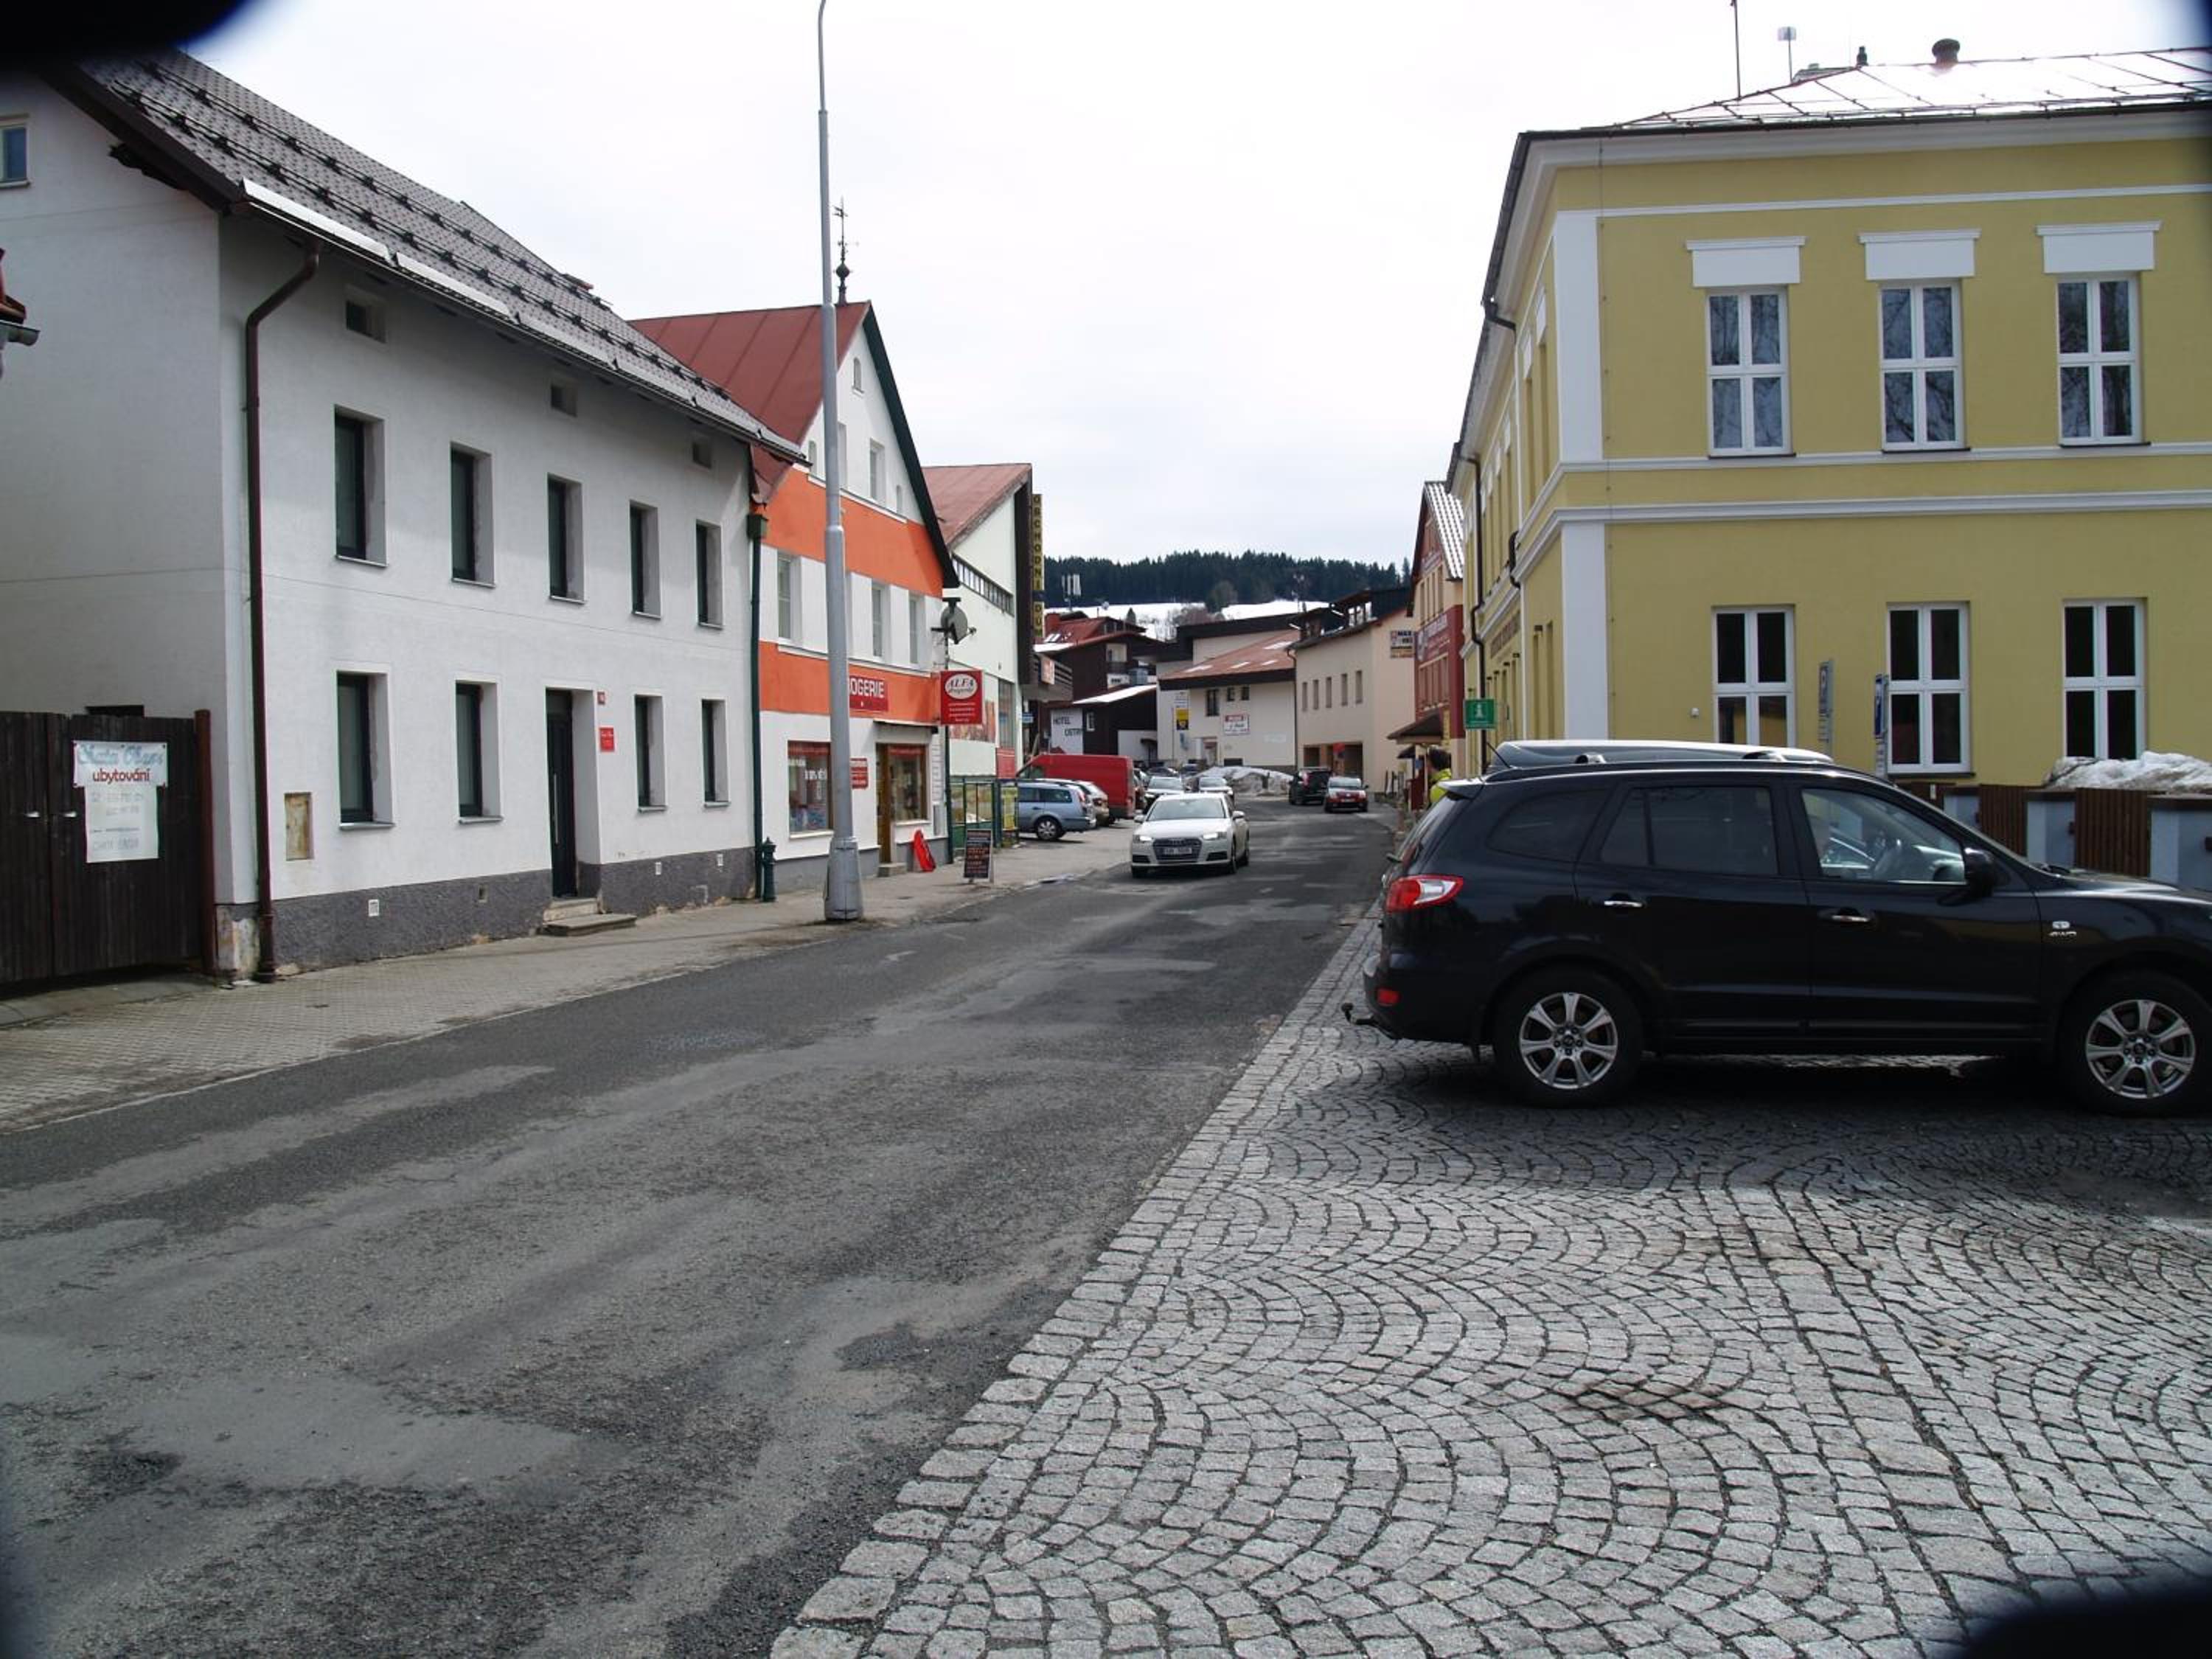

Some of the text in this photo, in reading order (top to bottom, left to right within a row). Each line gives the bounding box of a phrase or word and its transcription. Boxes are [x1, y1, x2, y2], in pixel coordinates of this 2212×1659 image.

[849, 677, 884, 698] OGERIE
[947, 676, 974, 688] ALFA
[1053, 716, 1071, 725] HOTEL
[92, 768, 150, 785] ubytování
